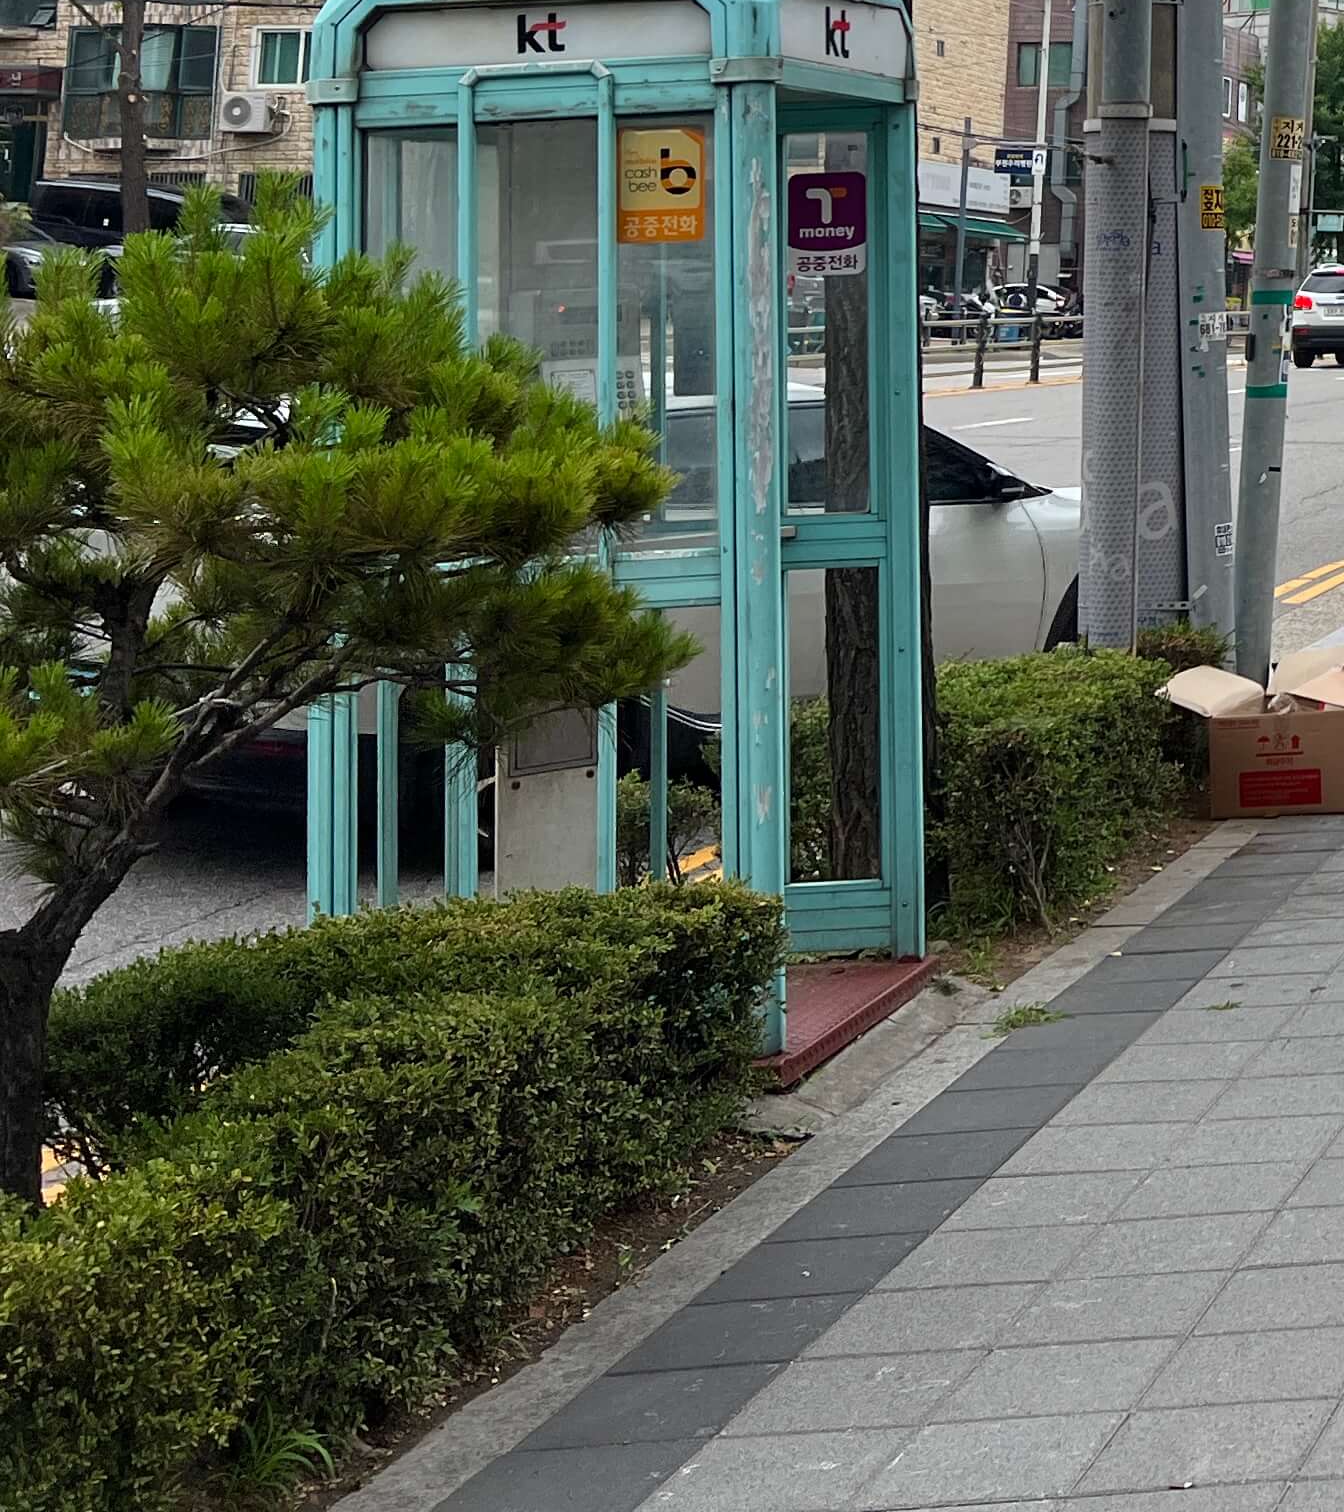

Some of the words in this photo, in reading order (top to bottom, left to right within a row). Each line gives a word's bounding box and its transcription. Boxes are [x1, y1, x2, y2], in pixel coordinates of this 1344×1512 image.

[517, 13, 567, 54] kt
[825, 6, 850, 59] kt
[624, 168, 657, 179] cash
[628, 181, 657, 192] bee
[624, 215, 697, 238] 공중전화
[799, 226, 855, 240] money
[797, 254, 858, 273] 공중전화
